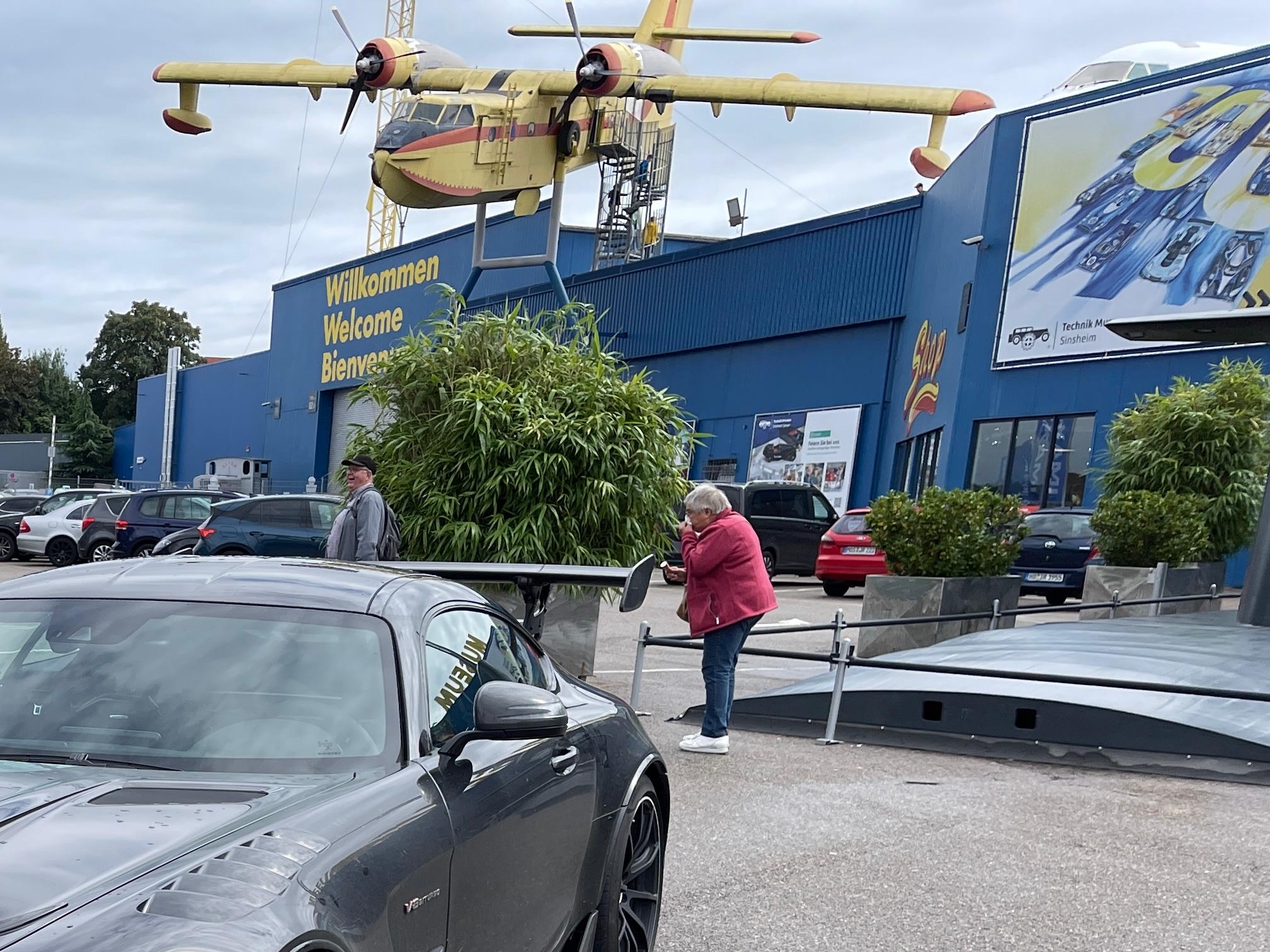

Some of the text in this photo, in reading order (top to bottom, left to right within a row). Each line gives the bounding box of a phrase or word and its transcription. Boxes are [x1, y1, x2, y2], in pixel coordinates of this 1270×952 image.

[325, 255, 439, 307] Willkommen
[323, 307, 403, 346] Welcome
[1060, 333, 1097, 346] Sinsheim
[1062, 320, 1093, 332] Technik
[321, 349, 393, 384] Bienven
[904, 319, 947, 420] Shop
[403, 897, 419, 914] V8
